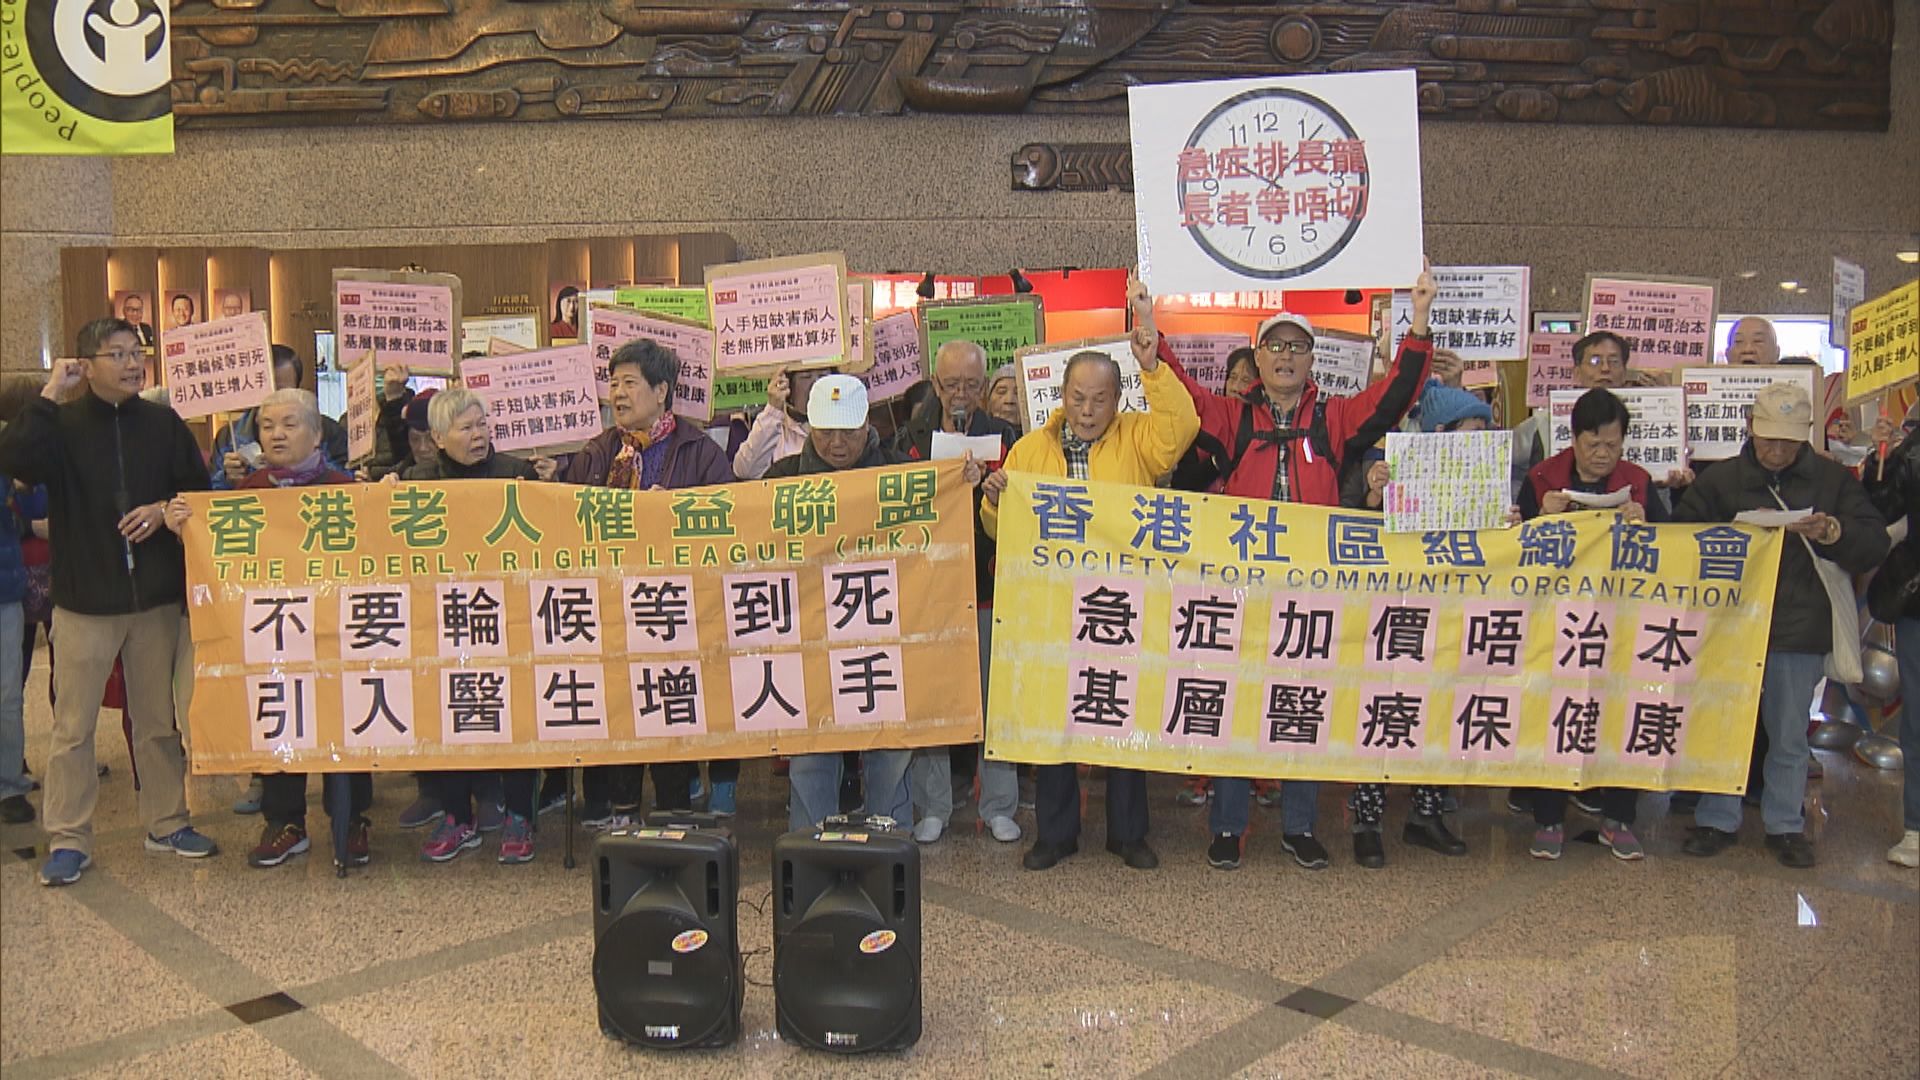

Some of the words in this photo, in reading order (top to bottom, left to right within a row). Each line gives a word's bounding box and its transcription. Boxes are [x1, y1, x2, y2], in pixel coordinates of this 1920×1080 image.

[1229, 123, 1247, 144] 11
[1253, 112, 1279, 133] 12
[1298, 118, 1306, 138] 1
[1177, 138, 1367, 182] 急症排長龍
[1203, 178, 1219, 197] 9
[1329, 171, 1345, 189] 3
[1179, 184, 1368, 227] 長者等唔切
[1241, 226, 1256, 247] 7
[1269, 235, 1286, 255] 6
[1301, 223, 1318, 243] 5
[720, 305, 835, 334] 人手短缺害病人
[1396, 308, 1516, 326] 人短缺害病人
[1593, 313, 1706, 334] 急症加價唔治本
[720, 328, 836, 355] 老無所醫點算好
[1395, 331, 1516, 348] 所醫點算好
[171, 348, 265, 379] 不要輪候等到死
[175, 370, 265, 403] 引入醫生增人手
[486, 387, 593, 417] 手短缺害病人
[487, 410, 597, 440] 無所醫點算好
[207, 470, 939, 557] 香港老人權益聯盟
[1031, 482, 1753, 581] 香港社區組織協會
[214, 559, 285, 581] THE
[306, 552, 480, 578] ELDERLY
[500, 547, 626, 574] RIGHT
[647, 542, 804, 567] LEAGUE
[1032, 545, 1180, 578] SOCIETY
[1200, 562, 1266, 586] FOR
[1286, 567, 1494, 596] COMMUNITY
[1510, 574, 1742, 608] ORGANIZATION
[250, 567, 893, 652] 不要輪候等到死
[1076, 585, 1698, 673] 急症加價唔治本
[255, 651, 898, 740] 引入醫生增人手
[1070, 666, 1686, 757] 基層醫療保健康
